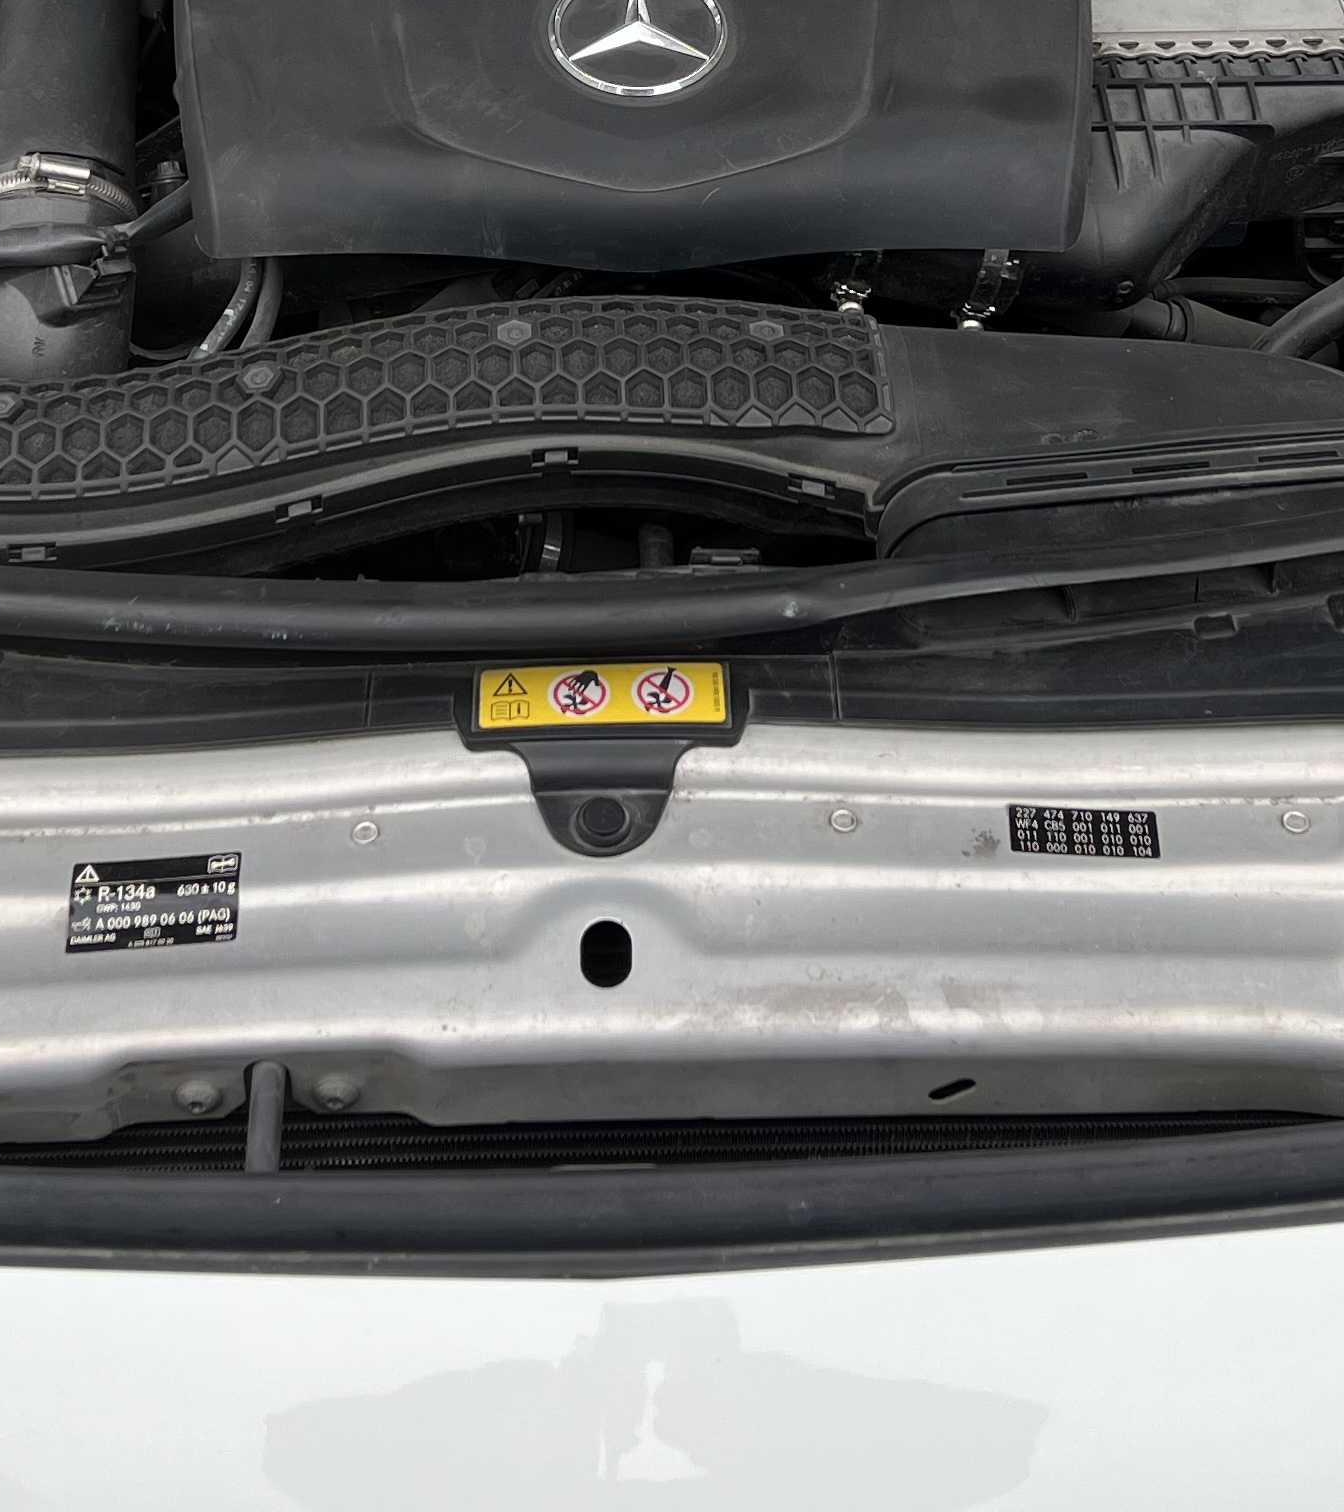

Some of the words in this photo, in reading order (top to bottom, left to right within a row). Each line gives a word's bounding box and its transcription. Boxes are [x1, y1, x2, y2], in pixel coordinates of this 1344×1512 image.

[1016, 807, 1036, 818] 227
[1043, 810, 1064, 820] 474
[1071, 812, 1092, 822] 710
[1100, 812, 1120, 822] 149
[1015, 819, 1038, 830] WF4
[1072, 822, 1093, 832] 001
[1100, 823, 1121, 833] 011
[1128, 824, 1149, 834] 001
[1017, 830, 1037, 840] 011
[1047, 831, 1066, 842] 110
[1073, 833, 1094, 843] 001
[1101, 834, 1123, 845] 010
[1129, 835, 1151, 845] 010
[1020, 841, 1040, 852] 110
[1046, 842, 1067, 853] 000
[1074, 843, 1096, 854] 010
[1102, 845, 1124, 856] 010
[1133, 846, 1152, 857] 104
[98, 884, 156, 903] R-134a
[213, 881, 226, 894] 10
[227, 881, 236, 896] g
[96, 917, 105, 930] A
[107, 915, 131, 930] 000
[160, 912, 176, 926] 06
[178, 910, 195, 925] 06
[197, 907, 231, 925] (PAG)
[104, 932, 117, 943] AG
[196, 924, 213, 936] SAE
